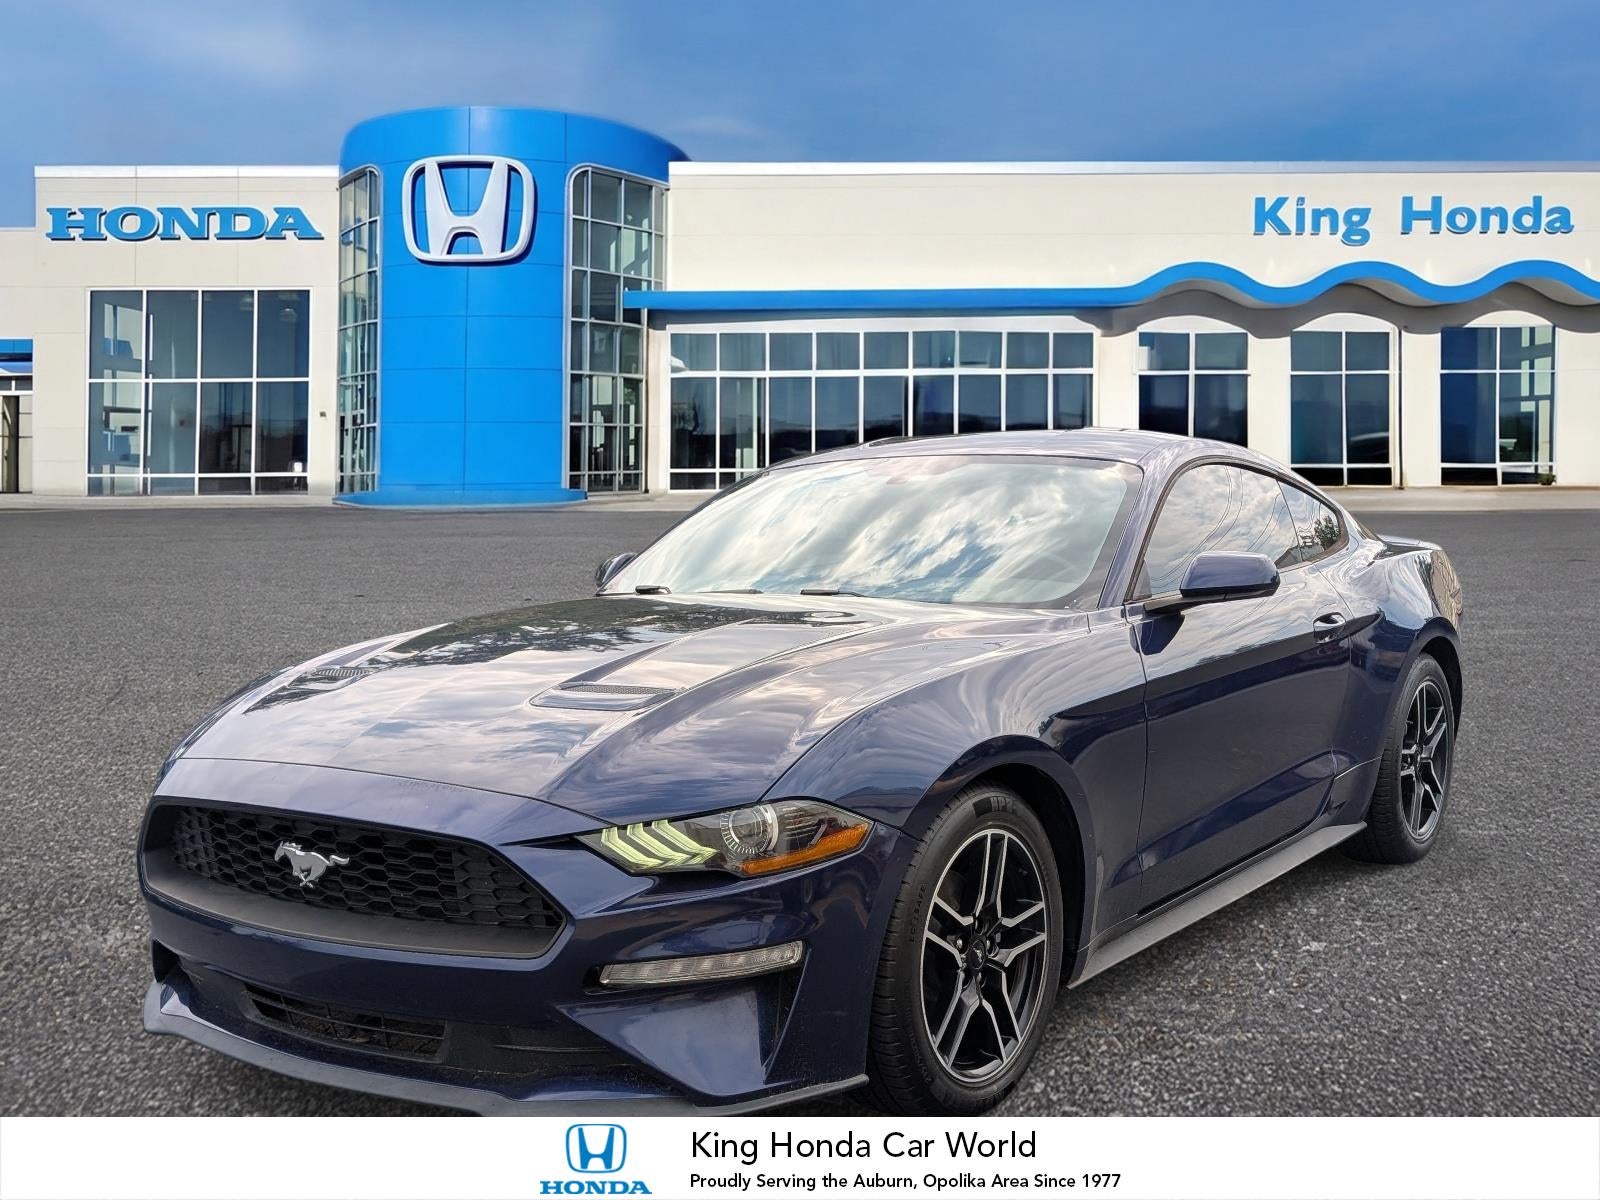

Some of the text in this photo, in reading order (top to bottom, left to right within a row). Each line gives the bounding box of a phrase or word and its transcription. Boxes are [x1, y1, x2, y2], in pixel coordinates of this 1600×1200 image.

[45, 206, 324, 241] HONDA
[1254, 195, 1574, 246] King Honda
